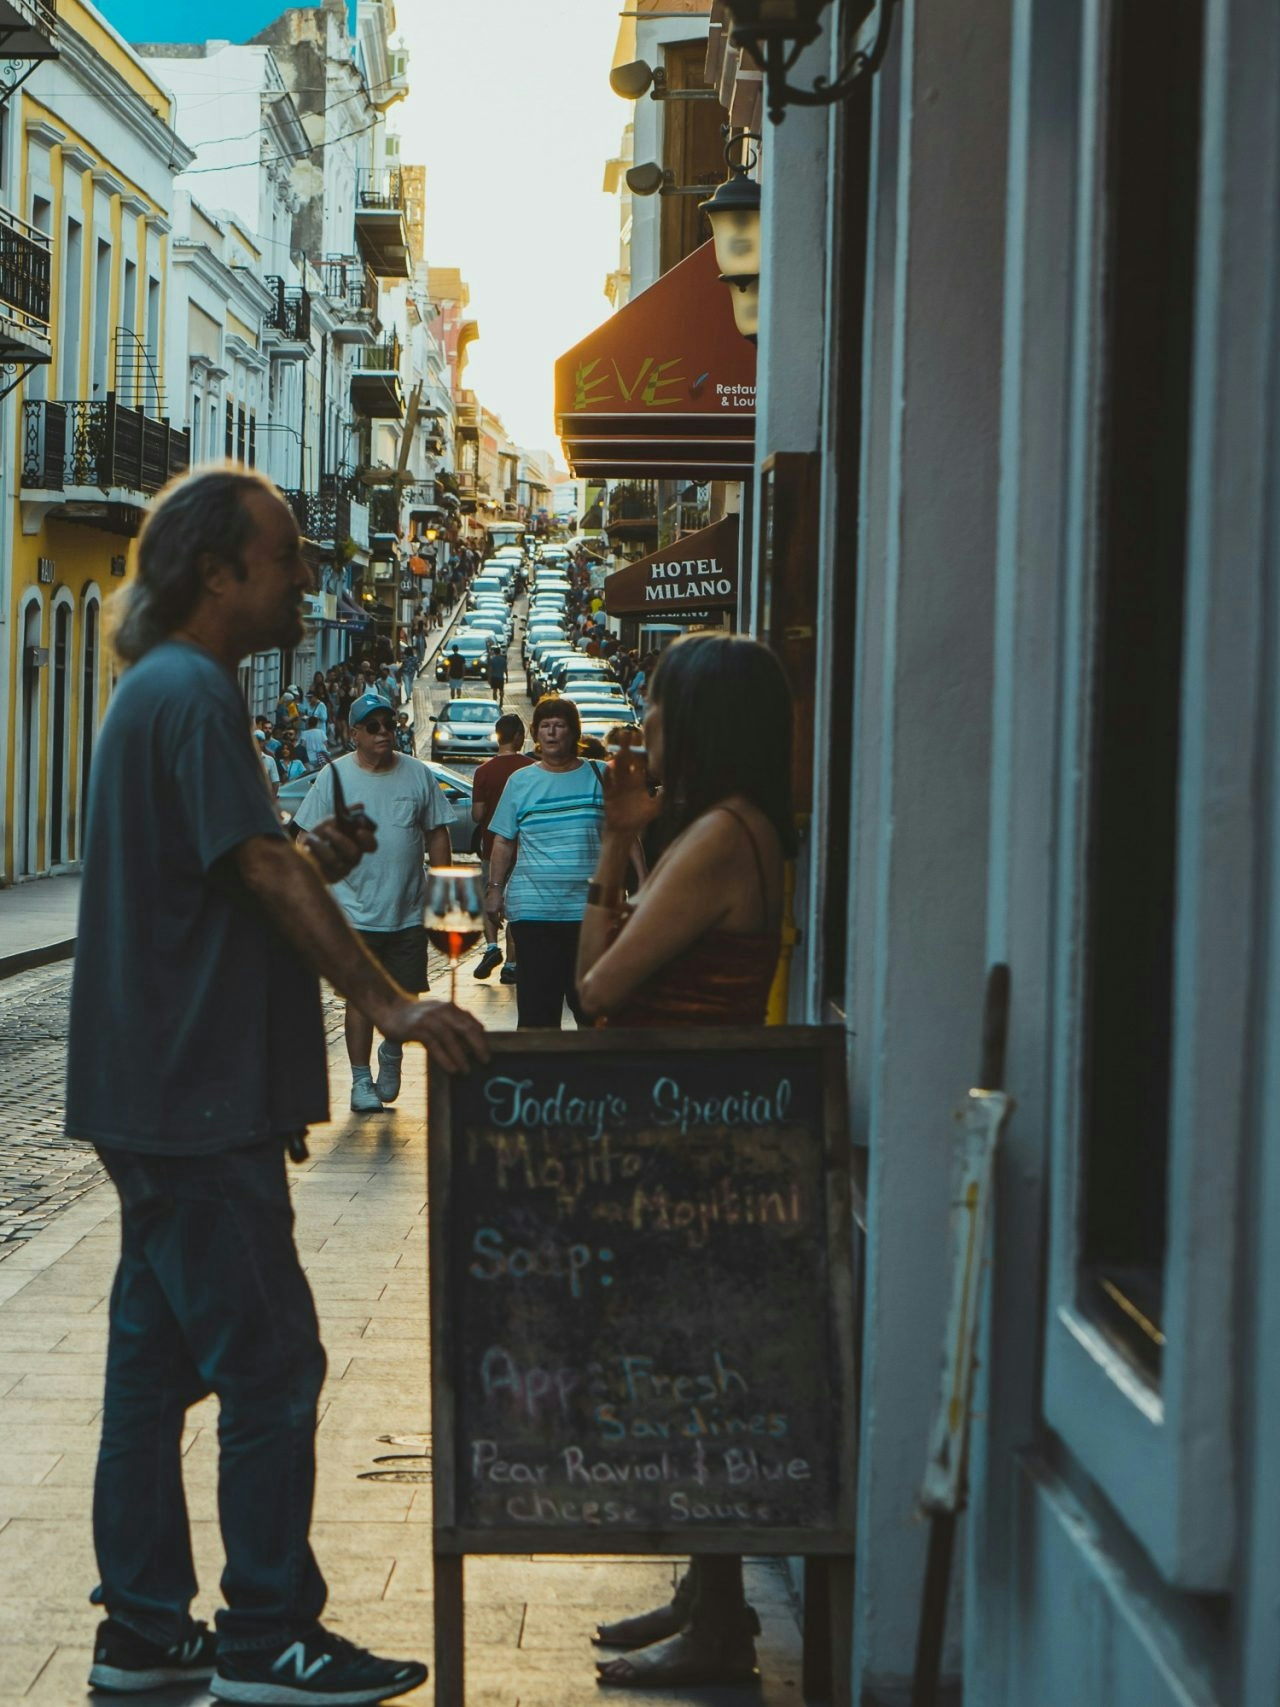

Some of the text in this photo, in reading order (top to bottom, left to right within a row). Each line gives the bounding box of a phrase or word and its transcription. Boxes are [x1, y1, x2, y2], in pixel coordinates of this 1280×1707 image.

[573, 357, 687, 410] EVE
[721, 396, 730, 407] &
[651, 558, 723, 579] HOTEL
[645, 579, 732, 601] MILANO
[483, 1076, 792, 1140] Today's Special
[615, 1347, 750, 1403] Fresh
[592, 1404, 790, 1441] Sardines
[472, 1439, 548, 1484] Pear
[561, 1445, 679, 1484] Ravioli
[724, 1447, 812, 1485] Blue
[670, 1491, 782, 1523] Sauce
